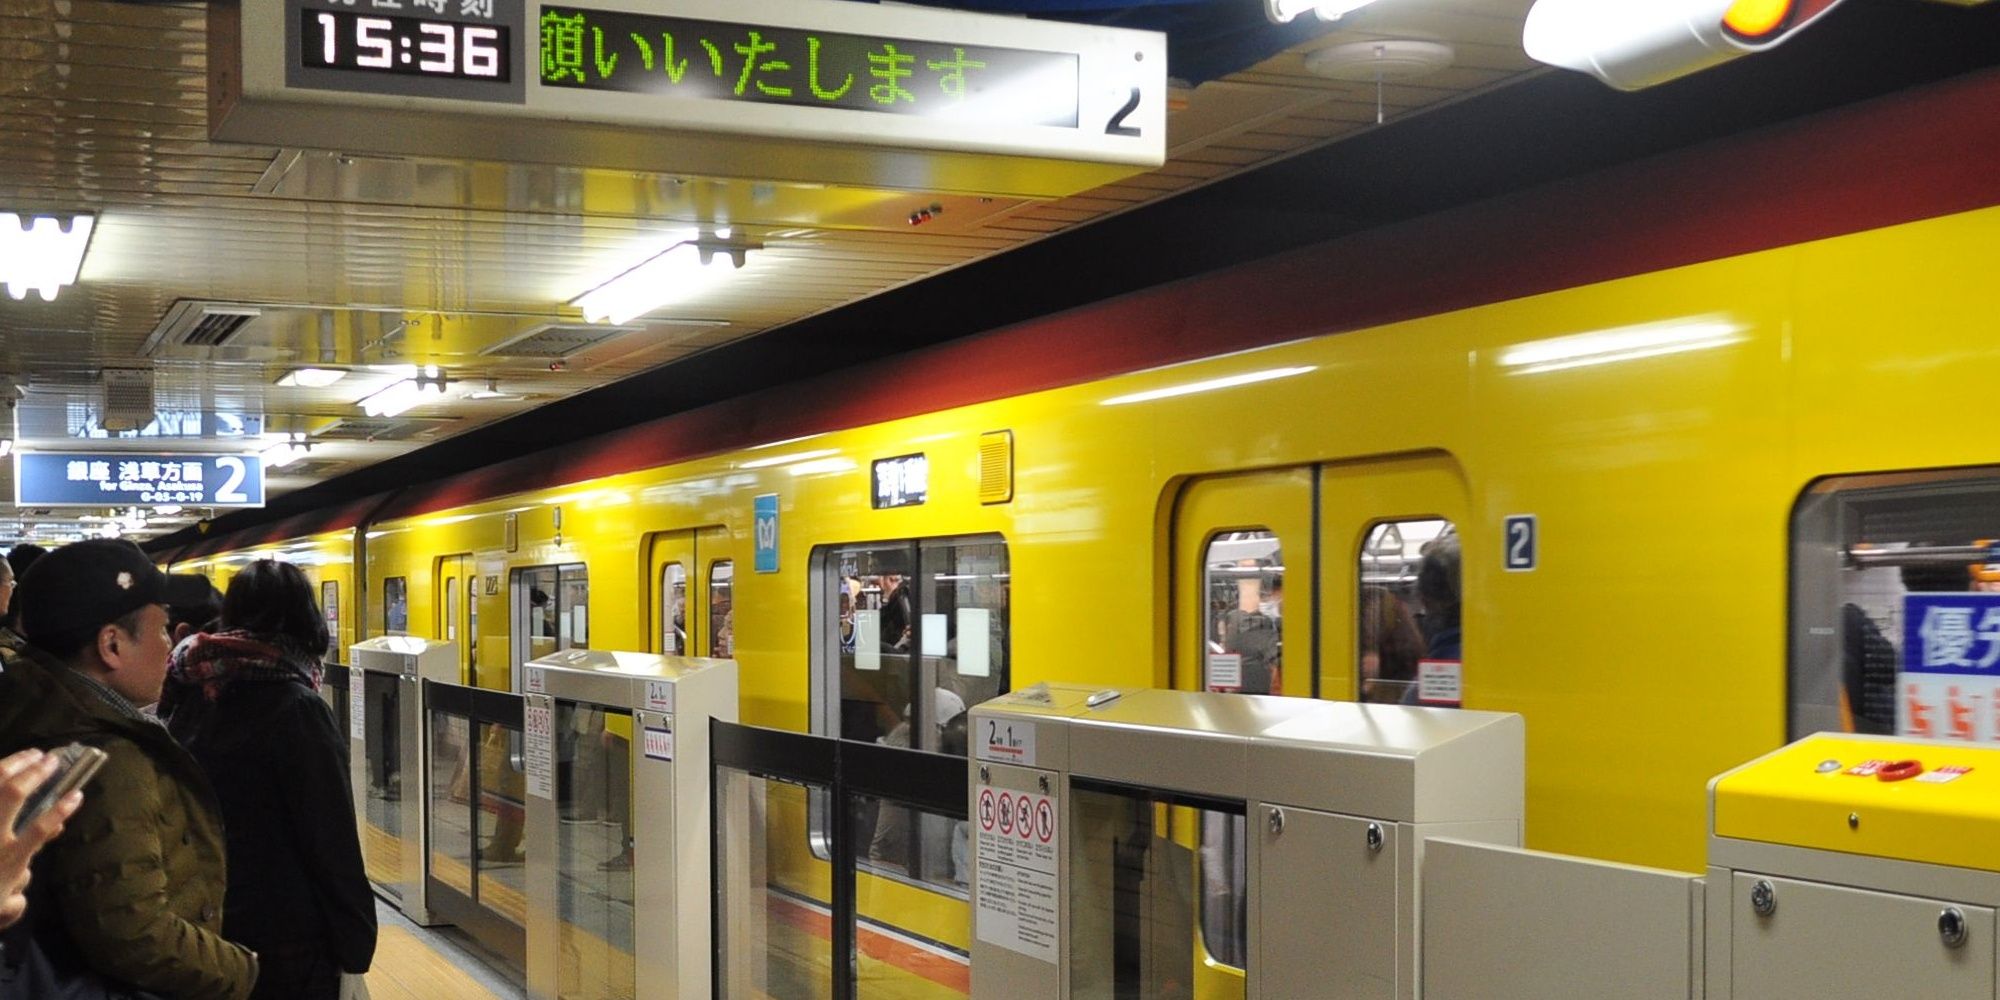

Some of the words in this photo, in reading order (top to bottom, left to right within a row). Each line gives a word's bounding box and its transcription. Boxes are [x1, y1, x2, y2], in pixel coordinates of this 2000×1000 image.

[318, 13, 498, 76] 15:36
[1105, 86, 1141, 137] 2
[67, 461, 110, 480] 銀座
[119, 461, 203, 481] 浅草方面
[215, 456, 248, 502] 2
[1511, 521, 1530, 566] 2
